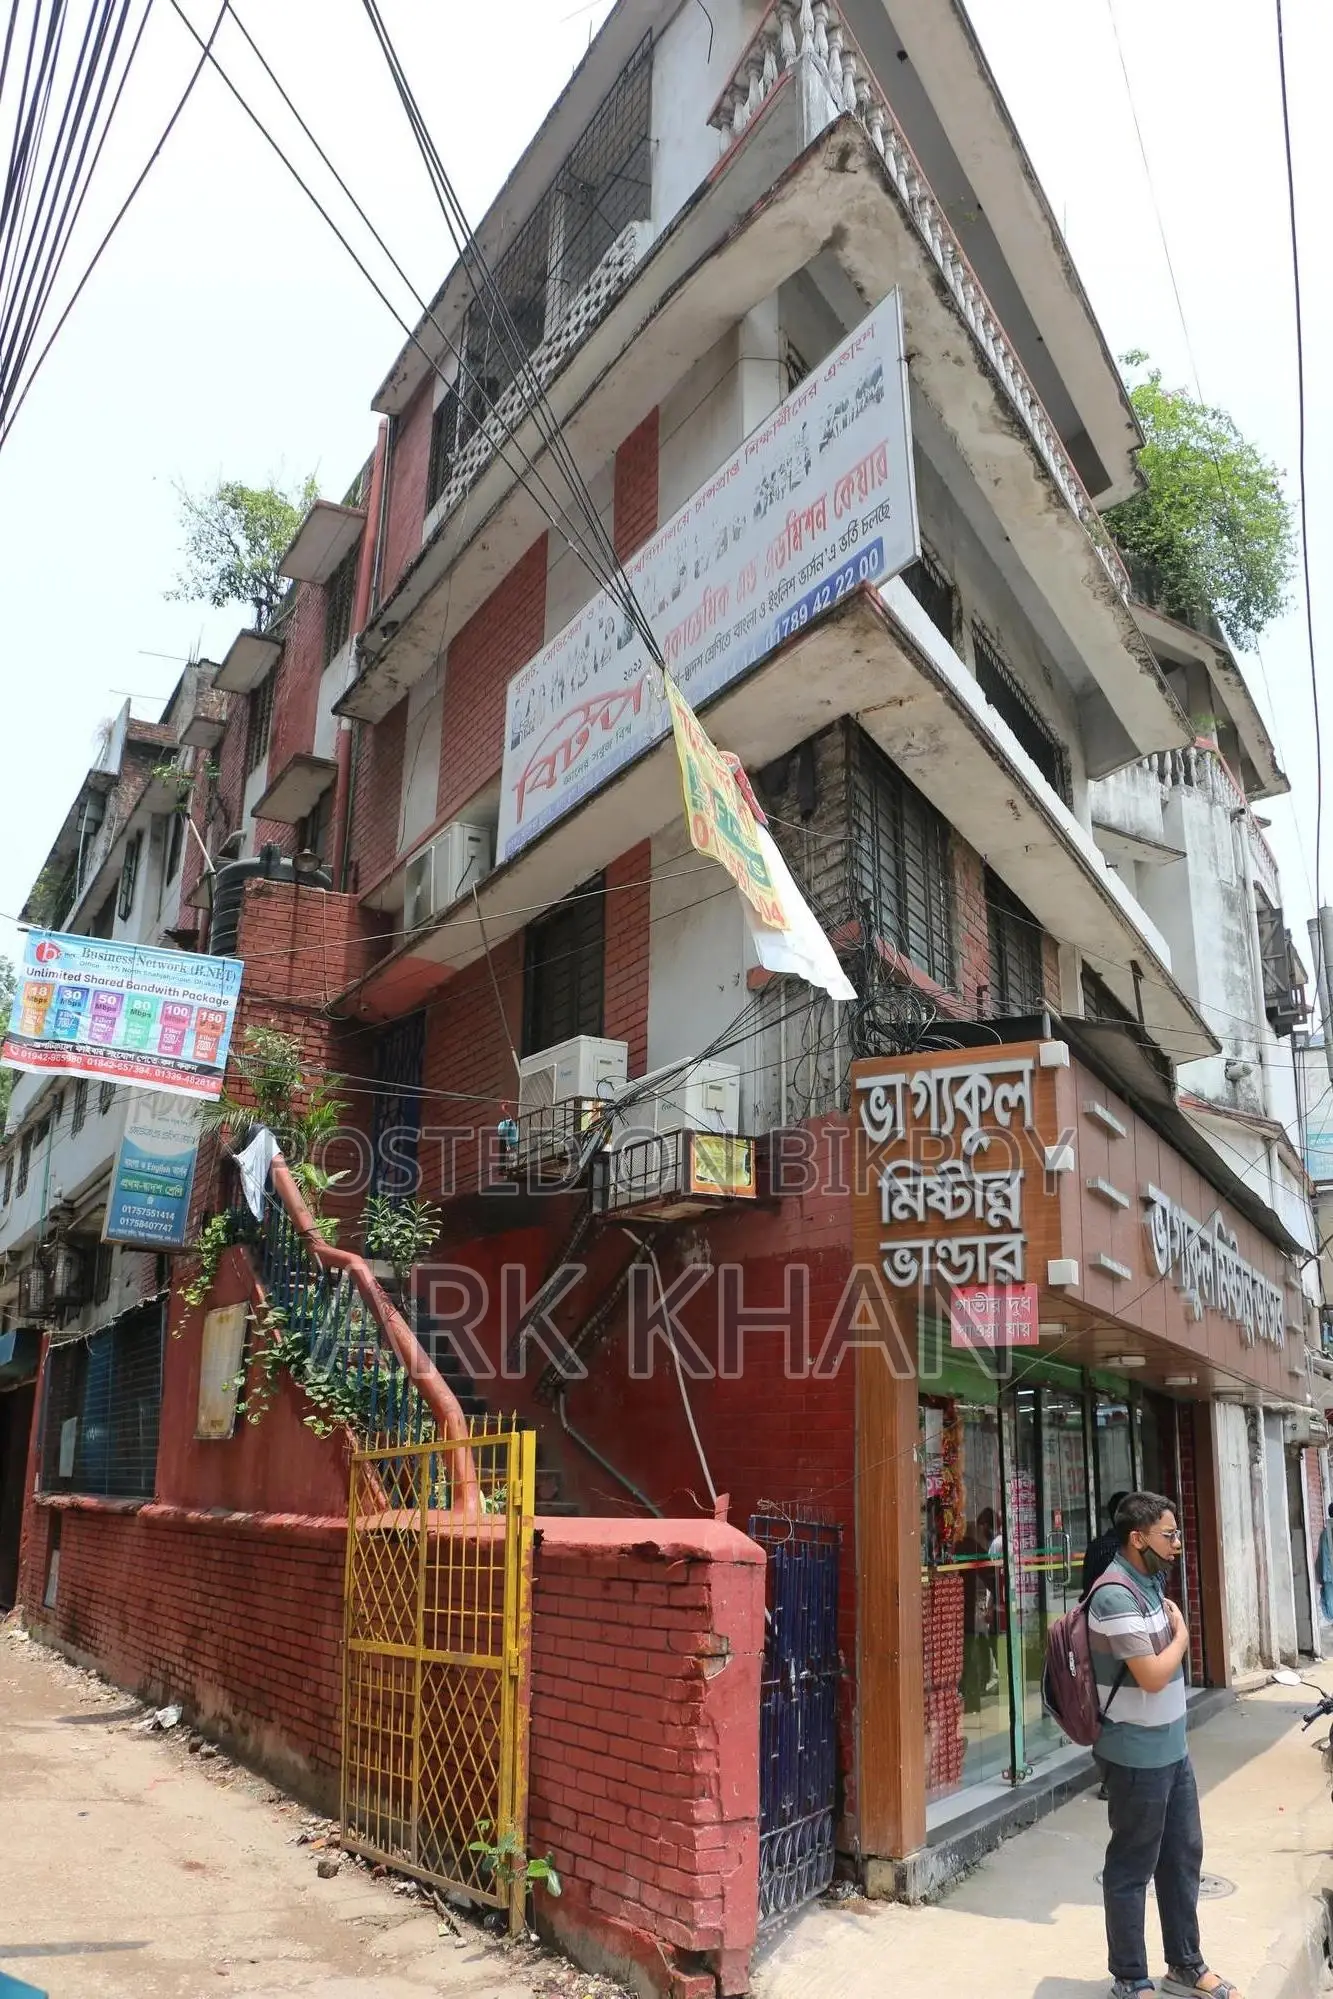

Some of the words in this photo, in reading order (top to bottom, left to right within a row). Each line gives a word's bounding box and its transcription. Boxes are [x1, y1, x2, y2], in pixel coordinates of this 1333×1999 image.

[833, 438, 889, 520] কেয়ার
[733, 607, 757, 638] বাংলা
[760, 601, 767, 620] ও
[768, 570, 796, 613] ইংলিশ
[838, 518, 860, 554] ভর্তি
[861, 498, 891, 535] চলছে
[812, 587, 831, 615] 42
[836, 567, 855, 595] 22
[859, 547, 879, 579] 00
[82, 947, 134, 966] Business
[136, 955, 187, 974] Network
[27, 967, 81, 982] Unlimited
[84, 974, 124, 988] Shared
[127, 980, 180, 998] Bandwith
[182, 990, 229, 1008] Package
[63, 989, 82, 999] 30
[98, 994, 117, 1005] 50
[95, 1003, 117, 1013] Mbps
[130, 1009, 151, 1018] Mbps
[167, 1006, 188, 1017] 100
[201, 1012, 222, 1023] 150
[856, 1056, 1035, 1157] ভাগ্যকুল
[878, 1159, 1025, 1229] মিষ্টান্ন
[955, 1291, 1000, 1317] গাভীর
[1006, 1296, 1032, 1319] দুধ
[1005, 1322, 1032, 1339] যায়
